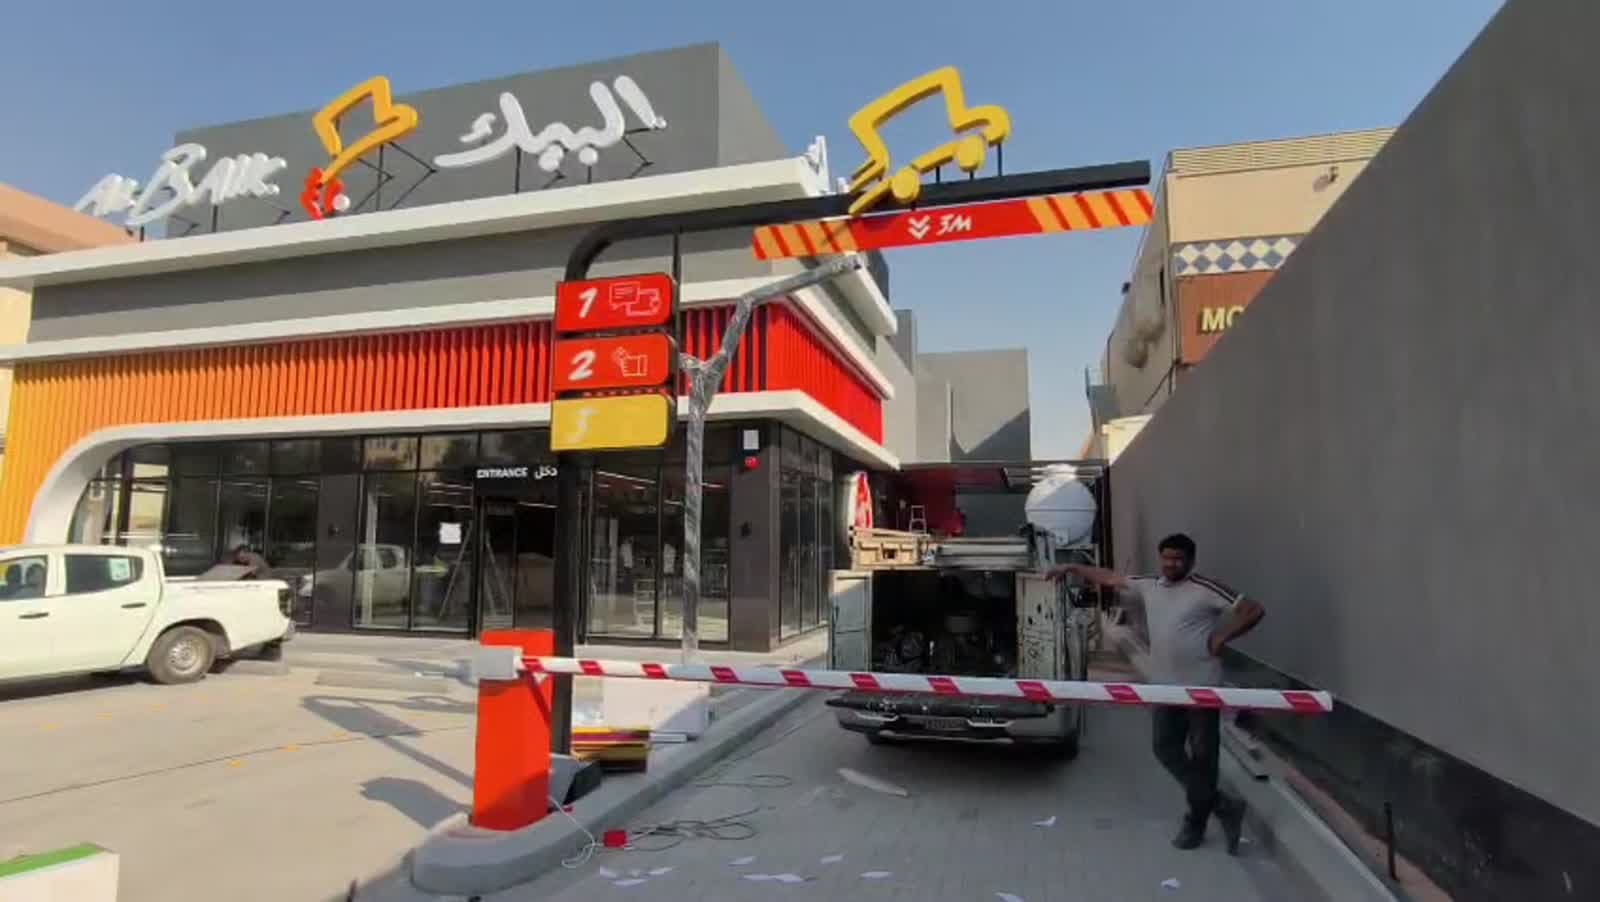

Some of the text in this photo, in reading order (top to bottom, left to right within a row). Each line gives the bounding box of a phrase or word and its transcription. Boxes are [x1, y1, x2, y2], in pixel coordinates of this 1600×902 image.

[434, 75, 667, 172] البيك
[936, 213, 973, 236] 3M
[578, 287, 598, 319] 1
[567, 349, 596, 382] 2
